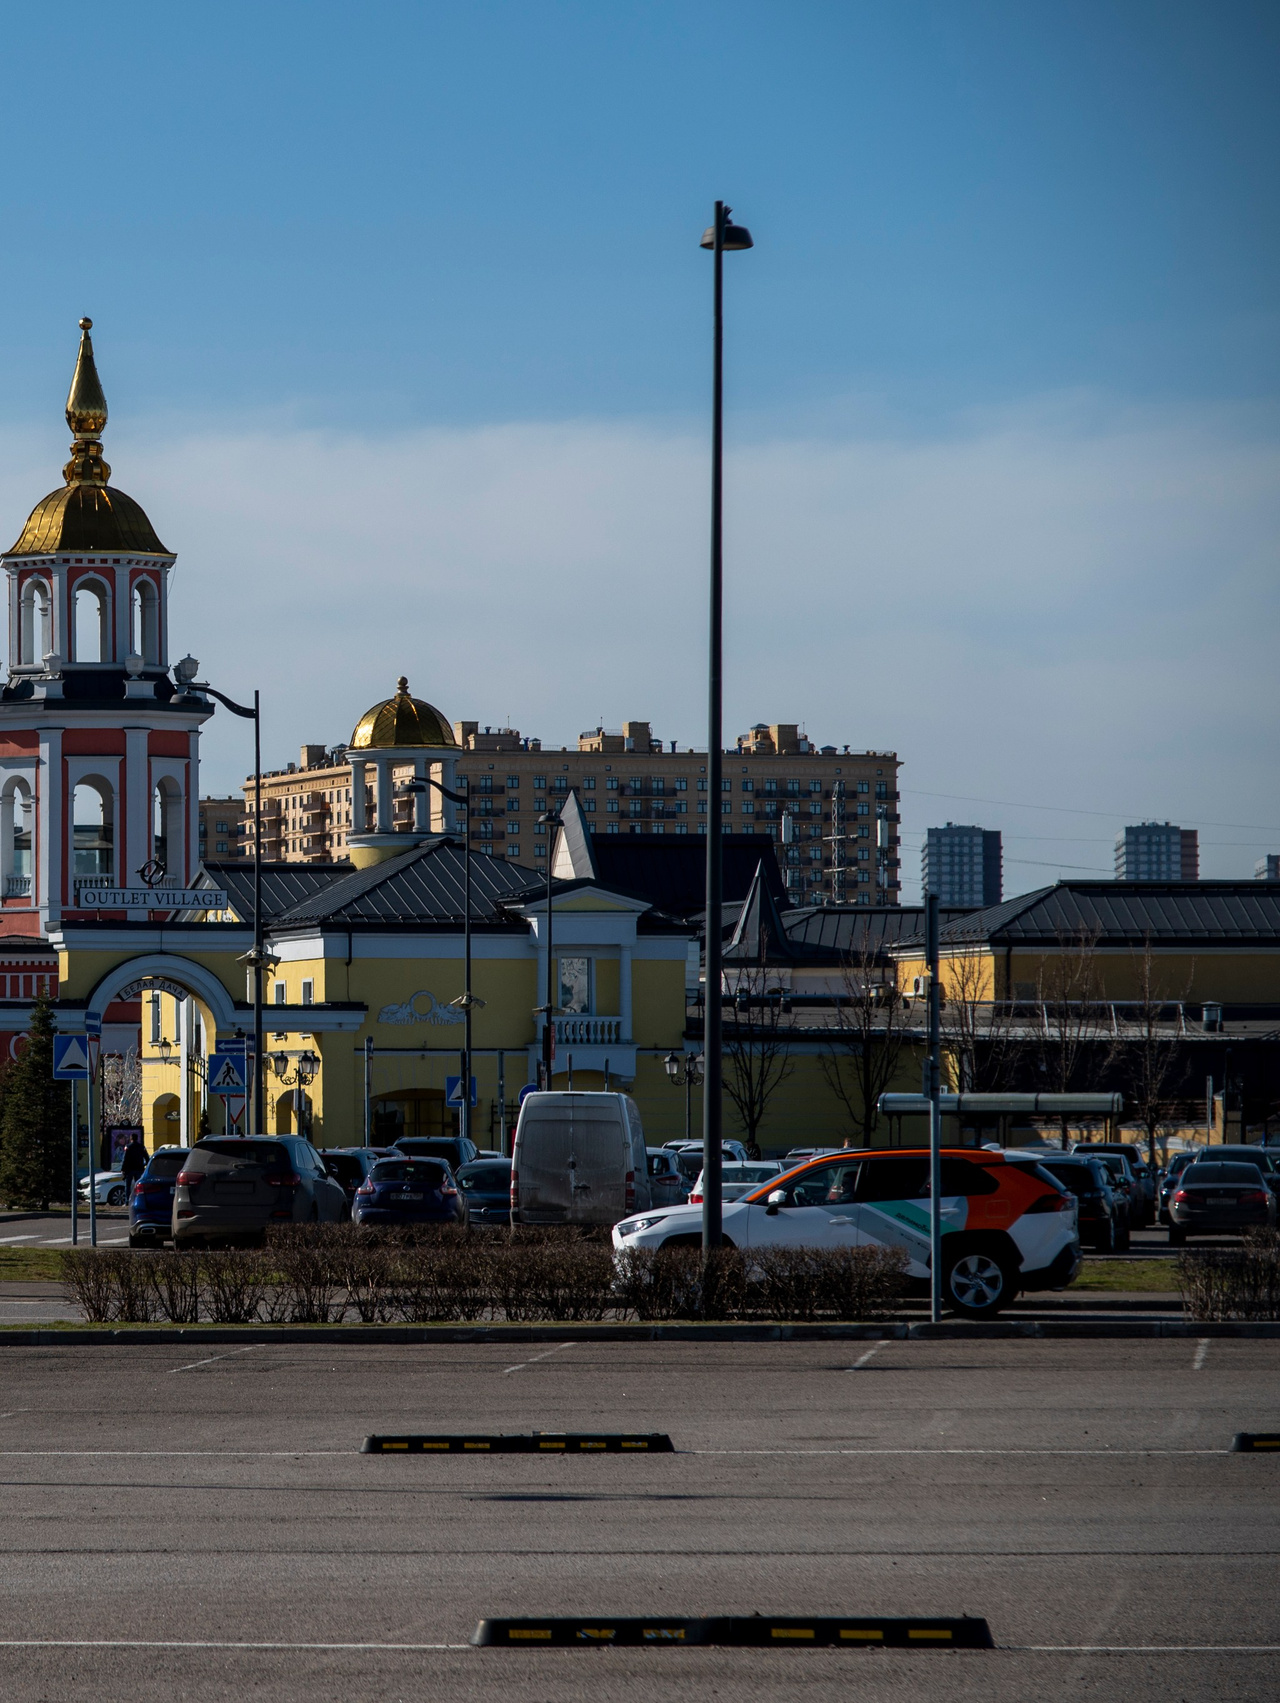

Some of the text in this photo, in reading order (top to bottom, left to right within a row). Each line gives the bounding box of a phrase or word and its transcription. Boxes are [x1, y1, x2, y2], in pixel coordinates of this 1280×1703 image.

[84, 891, 223, 906] OUTLET VILLAGE
[123, 980, 184, 997] БЕЛАЯ ДАЧА
